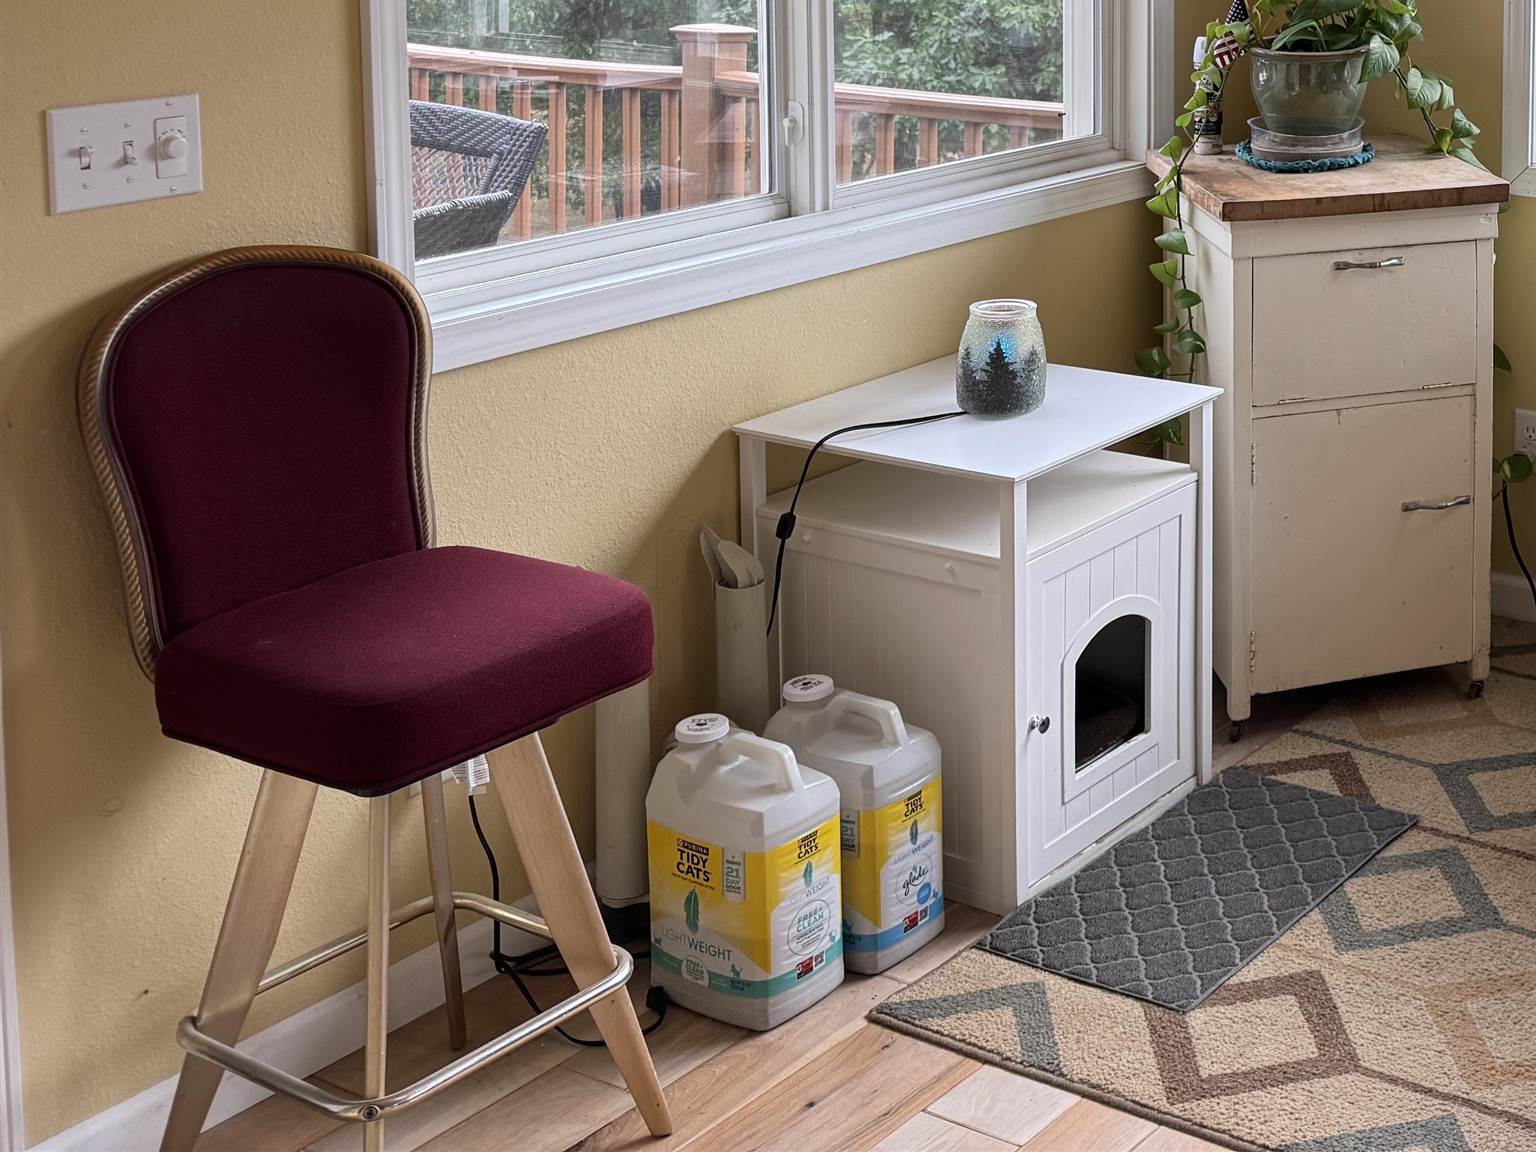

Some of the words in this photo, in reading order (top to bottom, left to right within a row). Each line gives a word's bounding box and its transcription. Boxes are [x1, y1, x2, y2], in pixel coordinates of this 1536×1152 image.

[904, 803, 924, 819] CATS
[905, 797, 922, 811] TIDY
[797, 842, 820, 860] CATS
[798, 837, 818, 852] TIDY
[677, 848, 709, 868] TIDY
[676, 861, 711, 883] CATS
[725, 866, 740, 879] 21
